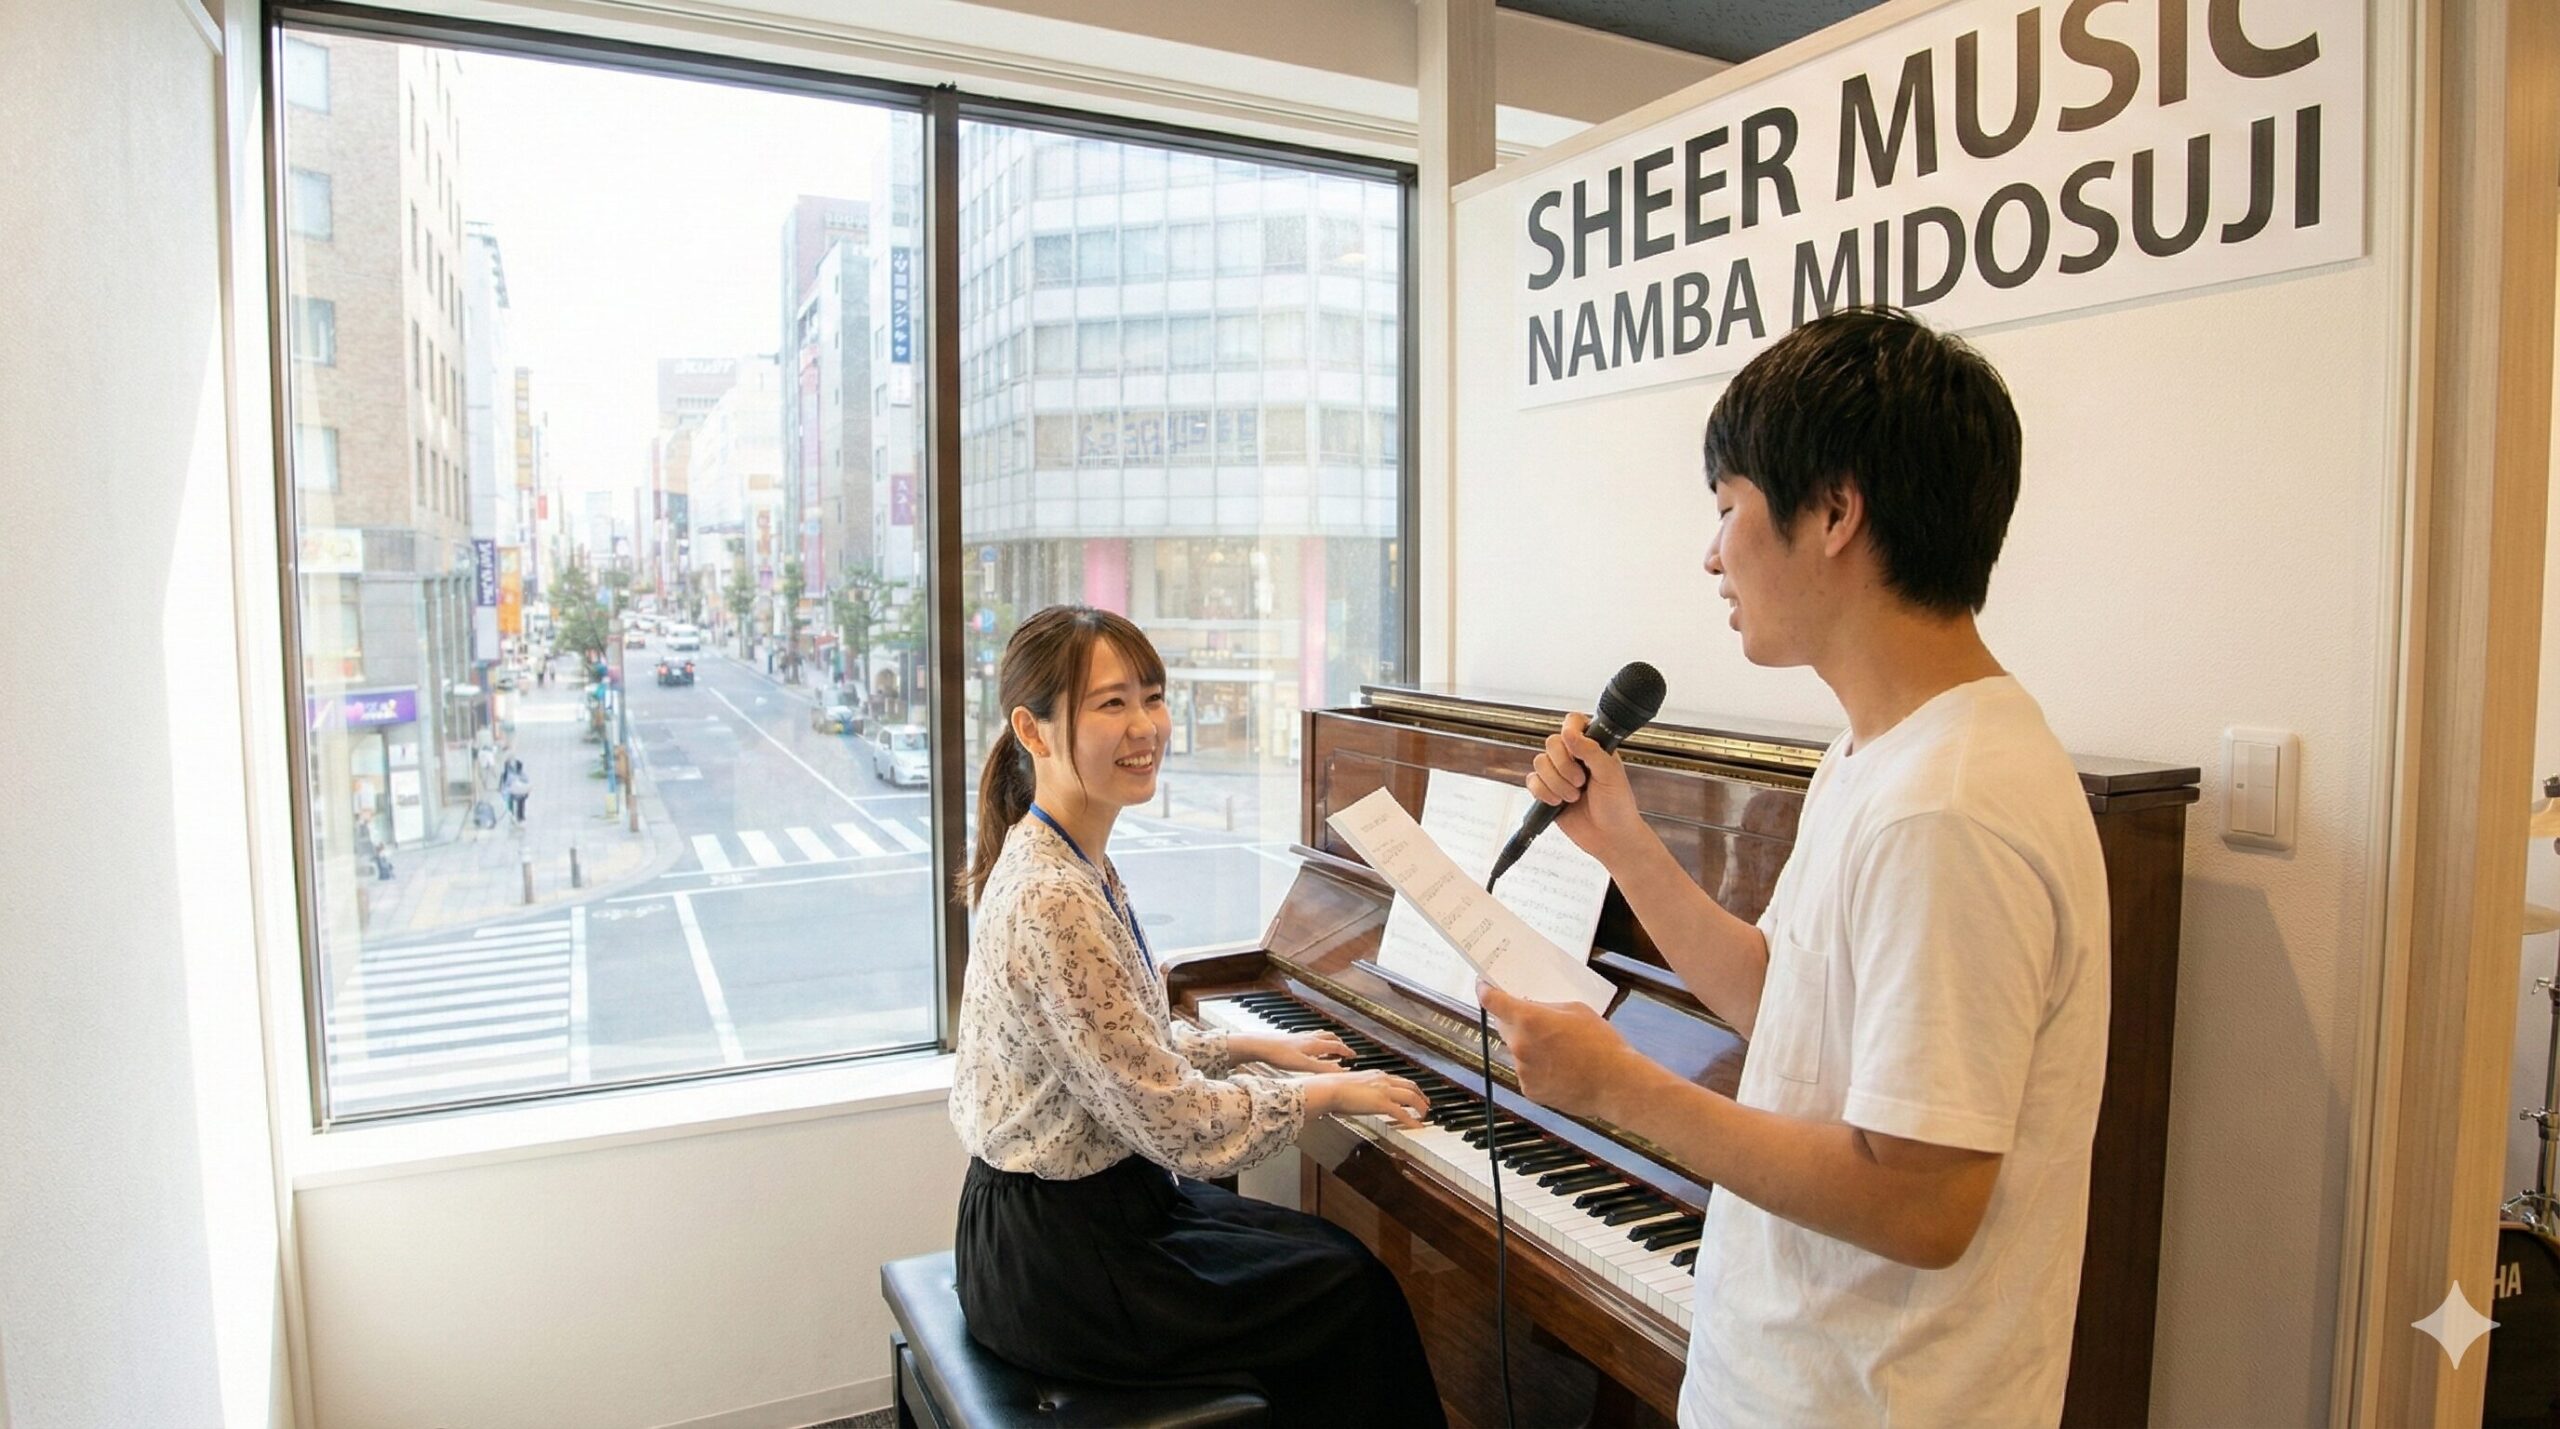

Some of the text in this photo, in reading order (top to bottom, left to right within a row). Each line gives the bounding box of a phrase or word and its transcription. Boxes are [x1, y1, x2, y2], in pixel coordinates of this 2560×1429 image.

[1527, 0, 2321, 291] SHEER MUSIC
[1528, 104, 2322, 386] NAMBA MIDOSUJI
